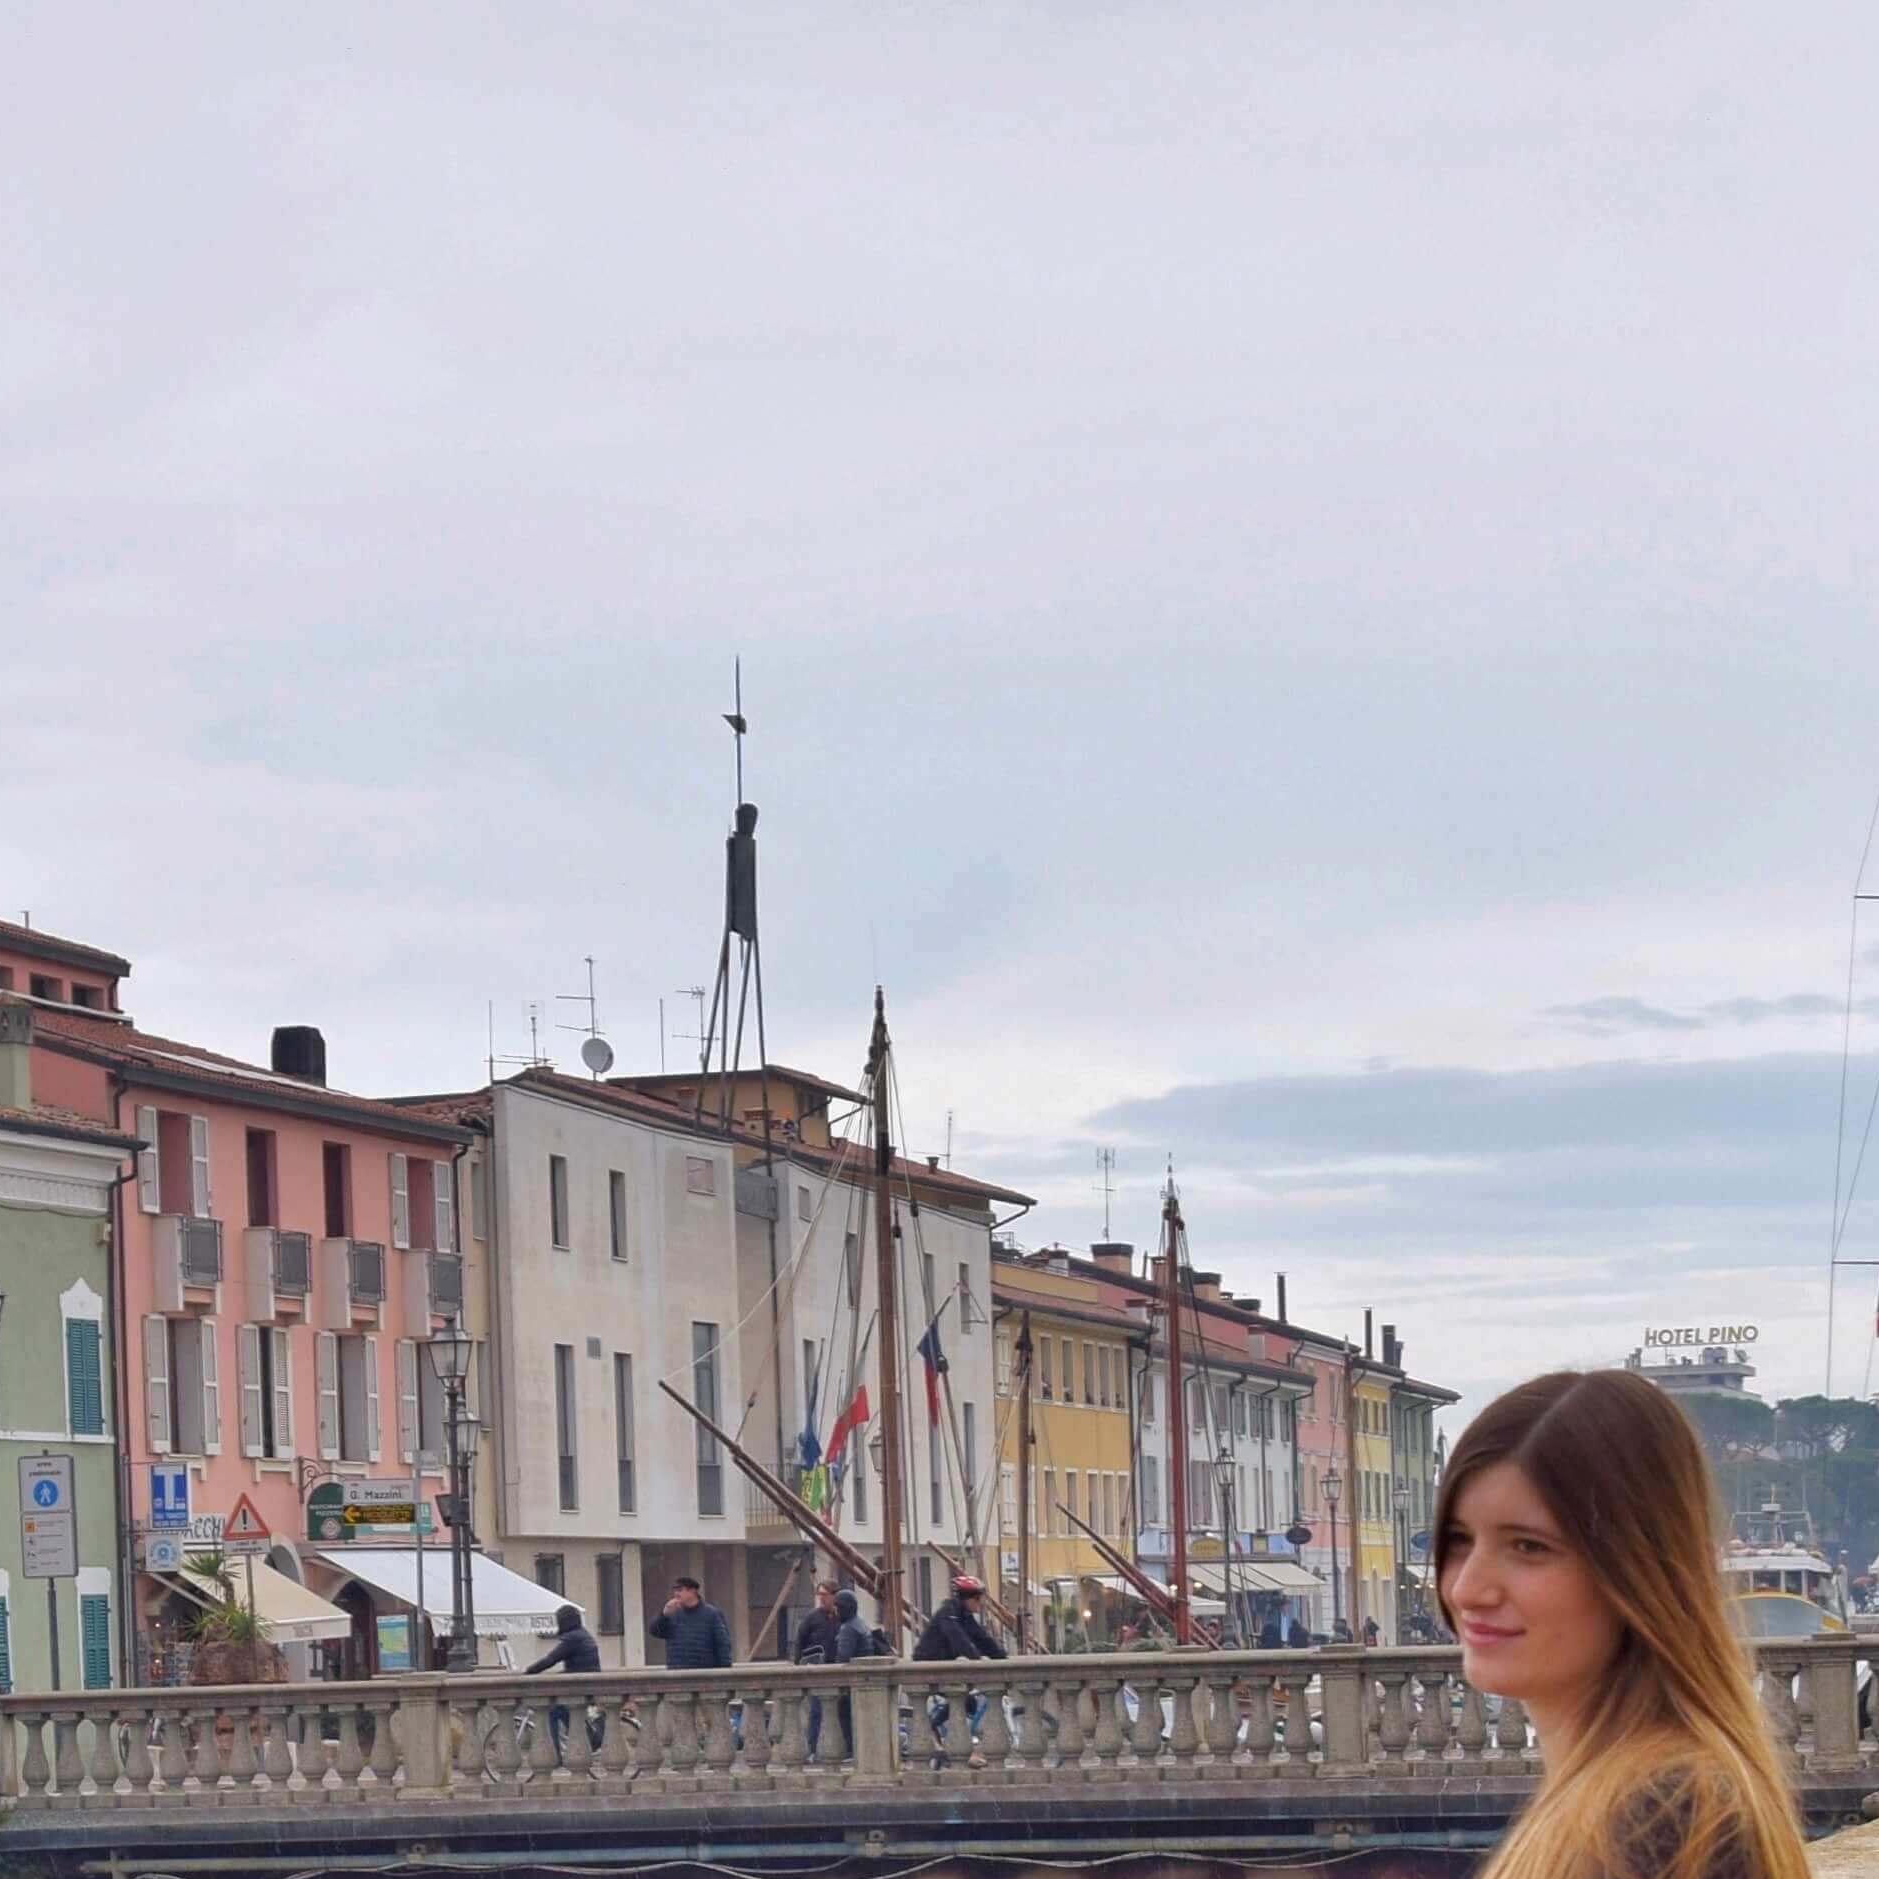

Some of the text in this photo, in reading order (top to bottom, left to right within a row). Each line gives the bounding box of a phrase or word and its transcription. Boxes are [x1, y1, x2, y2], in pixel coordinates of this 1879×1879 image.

[1644, 1325, 1759, 1347] HOTEL PINO
[364, 1489, 402, 1500] Mazzini
